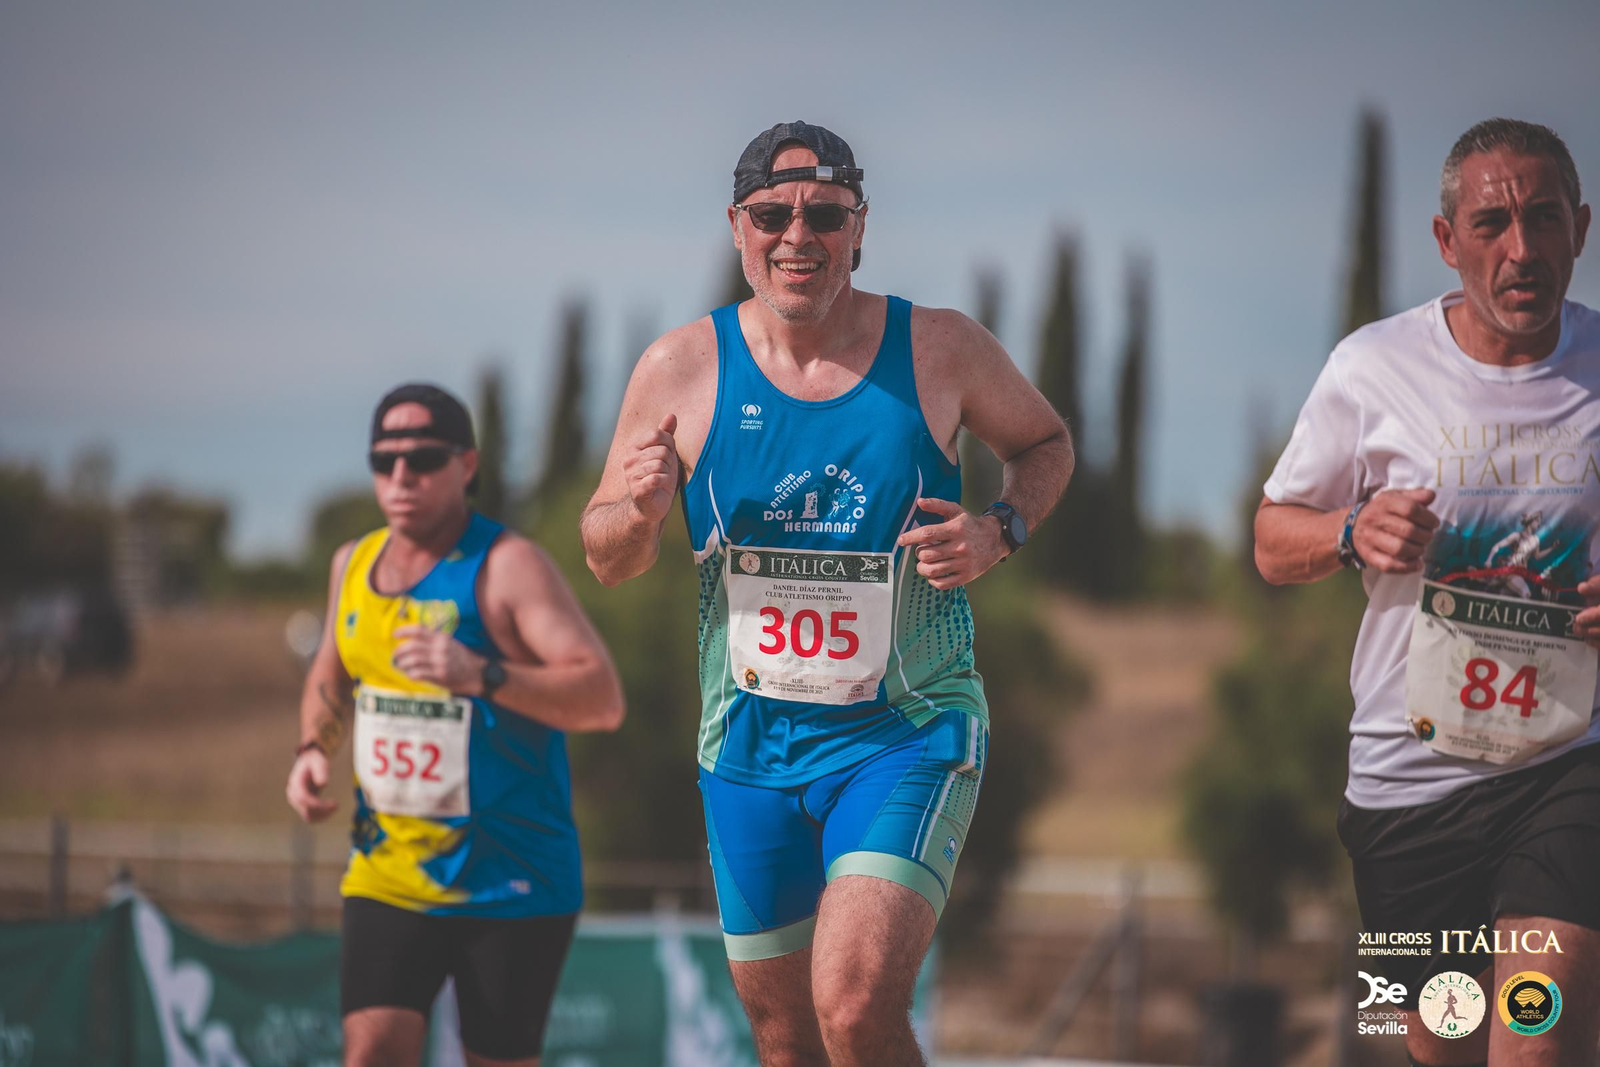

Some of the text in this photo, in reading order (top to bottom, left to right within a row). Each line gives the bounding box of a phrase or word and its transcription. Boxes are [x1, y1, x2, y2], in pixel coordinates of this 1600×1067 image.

[1439, 423, 1583, 450] XLIII CROSS
[770, 470, 812, 509] ATLETISMO
[774, 472, 796, 493] CLUB
[824, 463, 867, 519] ORIPPO
[763, 509, 793, 521] DOS
[784, 521, 857, 534] HERMANAS
[770, 554, 848, 576] ITÁLICA
[765, 591, 783, 599] CLUB
[783, 592, 824, 601] ATLETISMO
[773, 584, 844, 594] DANIEL DÍAZ PERNIL
[1467, 600, 1550, 630] ITÁLICA
[758, 606, 860, 660] 305
[1459, 657, 1540, 719] 84
[372, 738, 443, 782] 552
